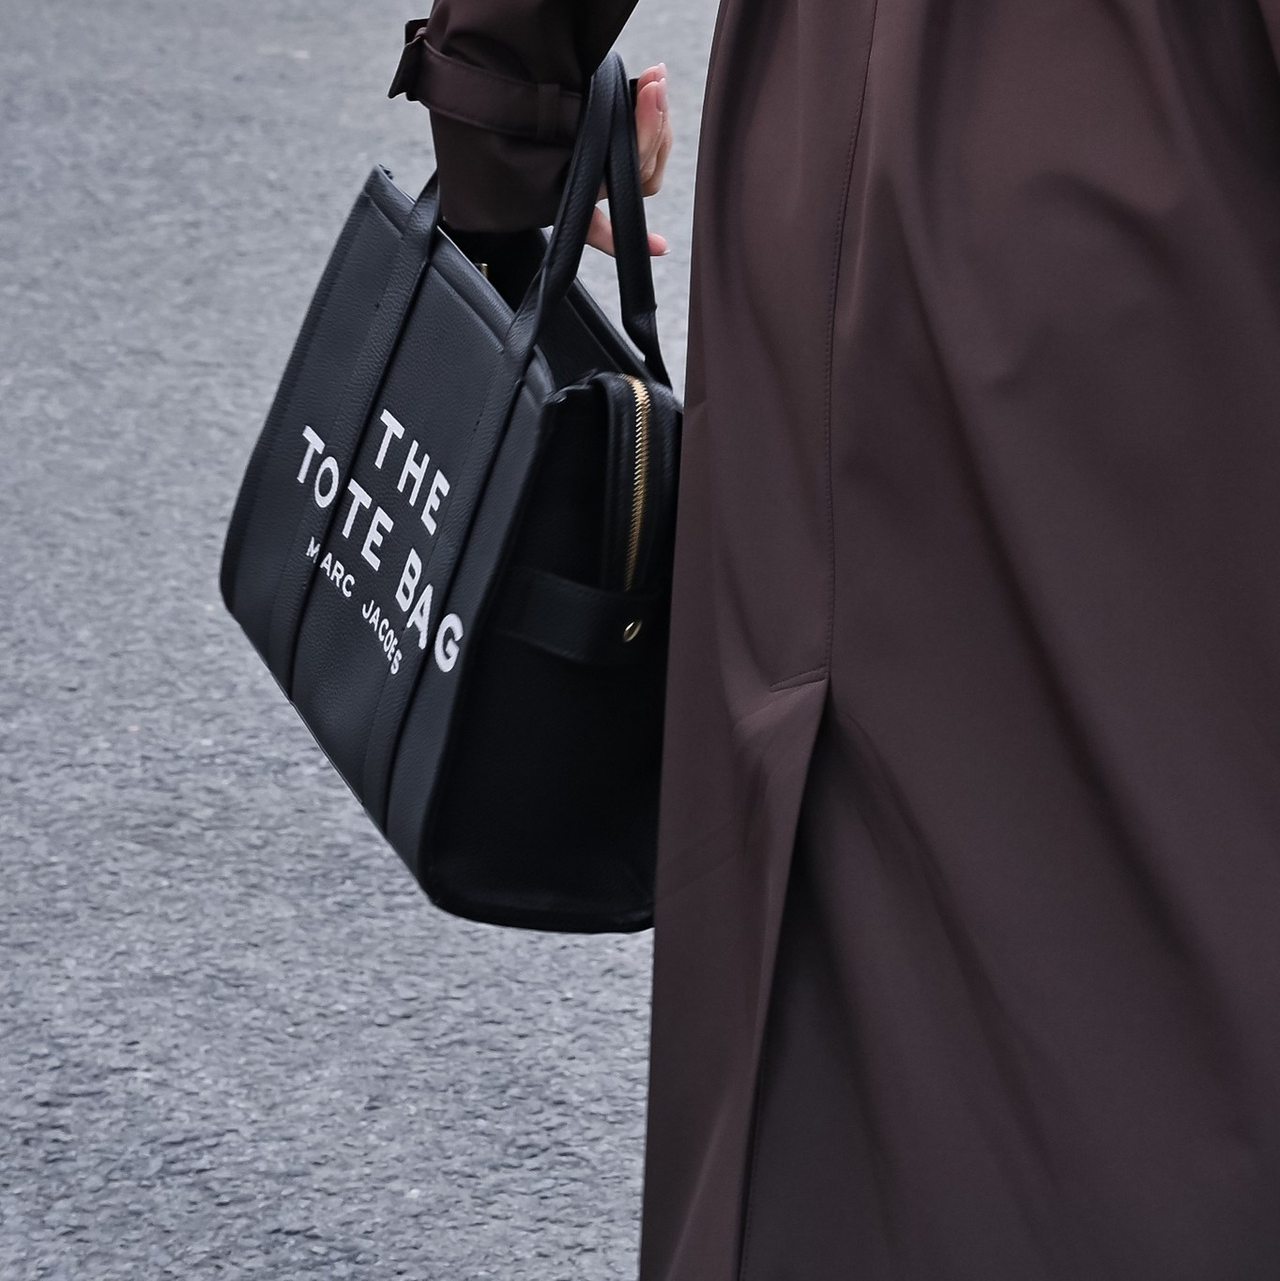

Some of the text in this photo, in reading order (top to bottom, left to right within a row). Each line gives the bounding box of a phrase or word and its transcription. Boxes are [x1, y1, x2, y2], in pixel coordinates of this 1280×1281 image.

[375, 408, 450, 536] THE
[296, 425, 464, 673] TOTE BAG
[306, 536, 356, 598] MARC
